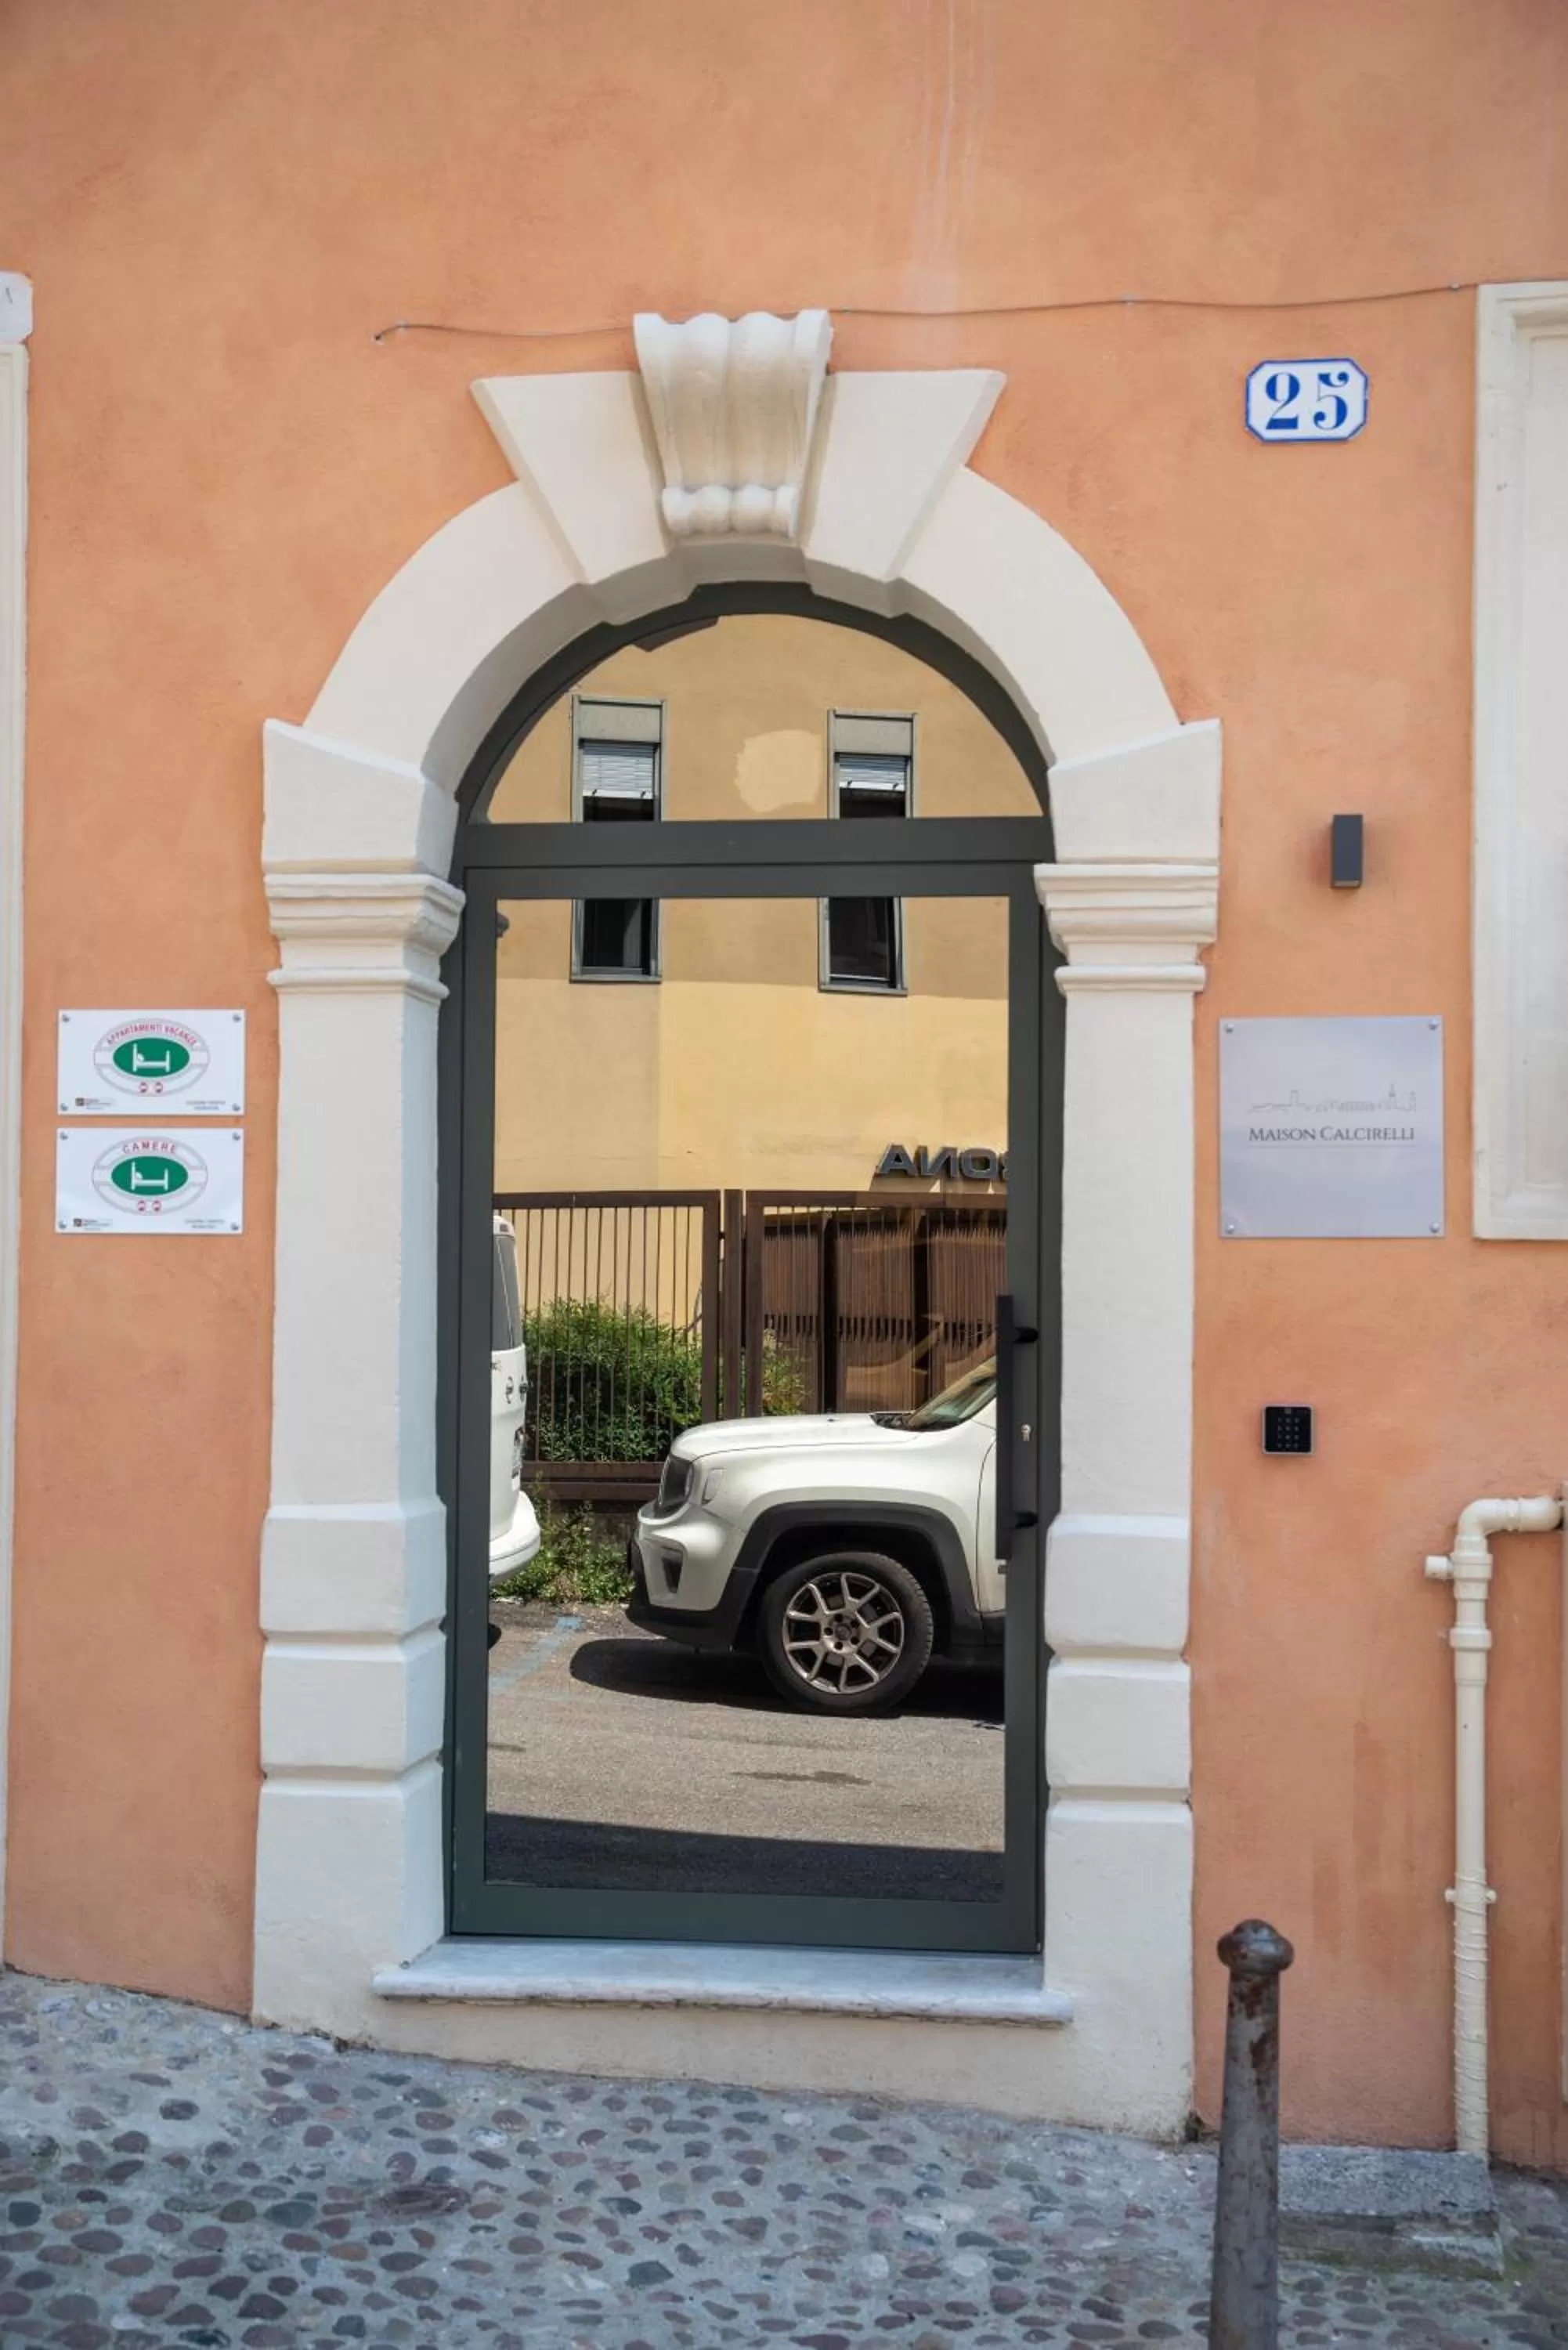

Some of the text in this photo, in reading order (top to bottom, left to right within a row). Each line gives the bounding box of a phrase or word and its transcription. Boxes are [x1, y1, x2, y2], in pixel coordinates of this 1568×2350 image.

[1265, 371, 1349, 430] 25
[1248, 1125, 1415, 1141] MAISON CALCIRELLI
[121, 1141, 177, 1155] CAMERE
